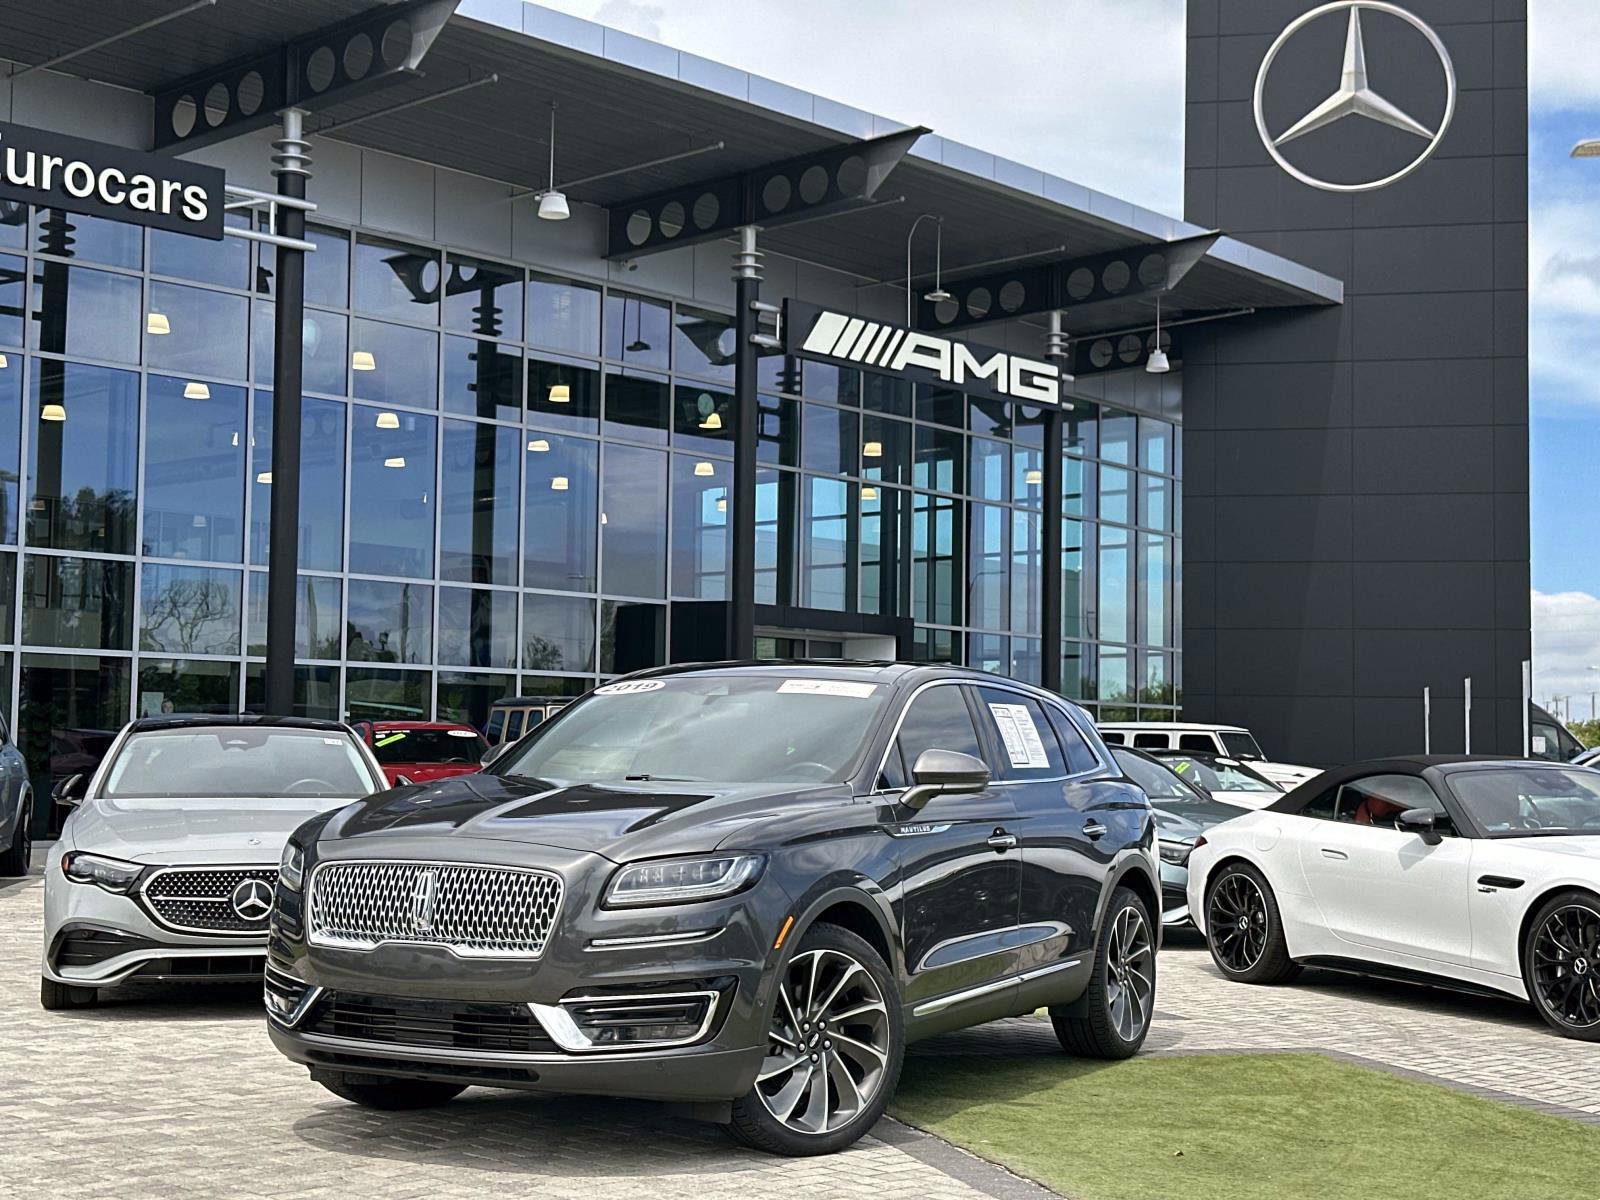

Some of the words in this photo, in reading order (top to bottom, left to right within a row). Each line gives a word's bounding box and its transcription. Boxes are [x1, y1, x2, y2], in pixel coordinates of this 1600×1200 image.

[0, 132, 208, 221] urocars
[890, 331, 1059, 405] AMG
[601, 682, 658, 693] 2019
[900, 825, 931, 833] NAUTILUS
